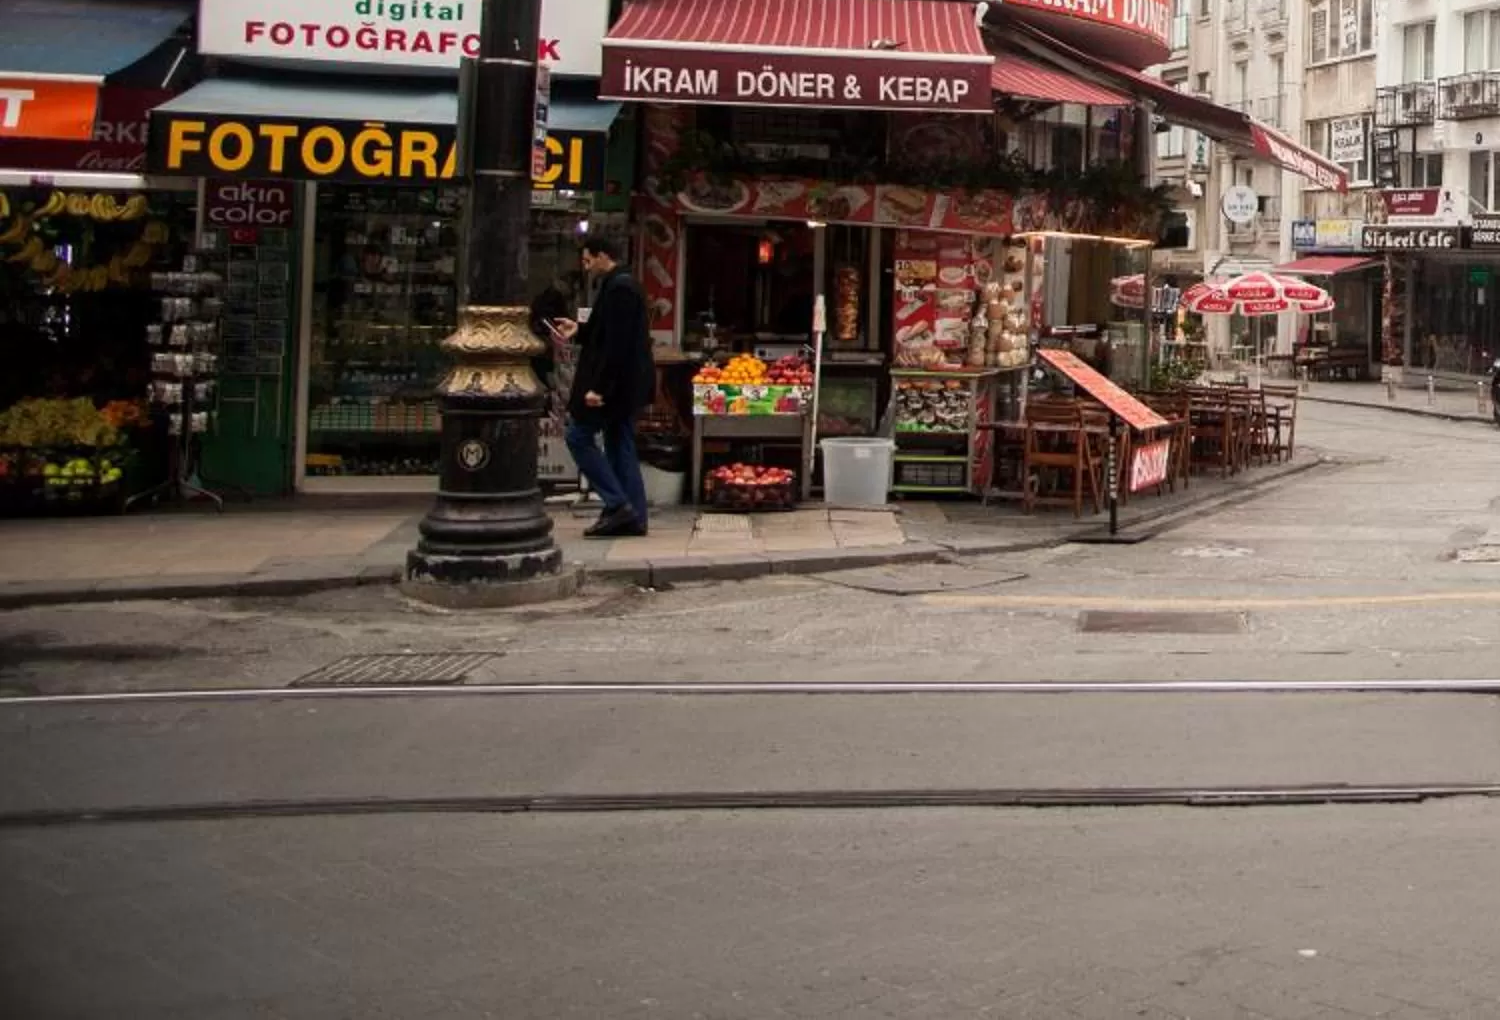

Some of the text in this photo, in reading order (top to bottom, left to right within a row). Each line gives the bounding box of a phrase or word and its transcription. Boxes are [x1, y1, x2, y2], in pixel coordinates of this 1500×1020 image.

[624, 59, 970, 103] İKRAM DÖNER & KEBAP
[167, 119, 583, 189] FOTOĞRÇI
[209, 205, 293, 225] color
[1419, 230, 1453, 247] Cafe
